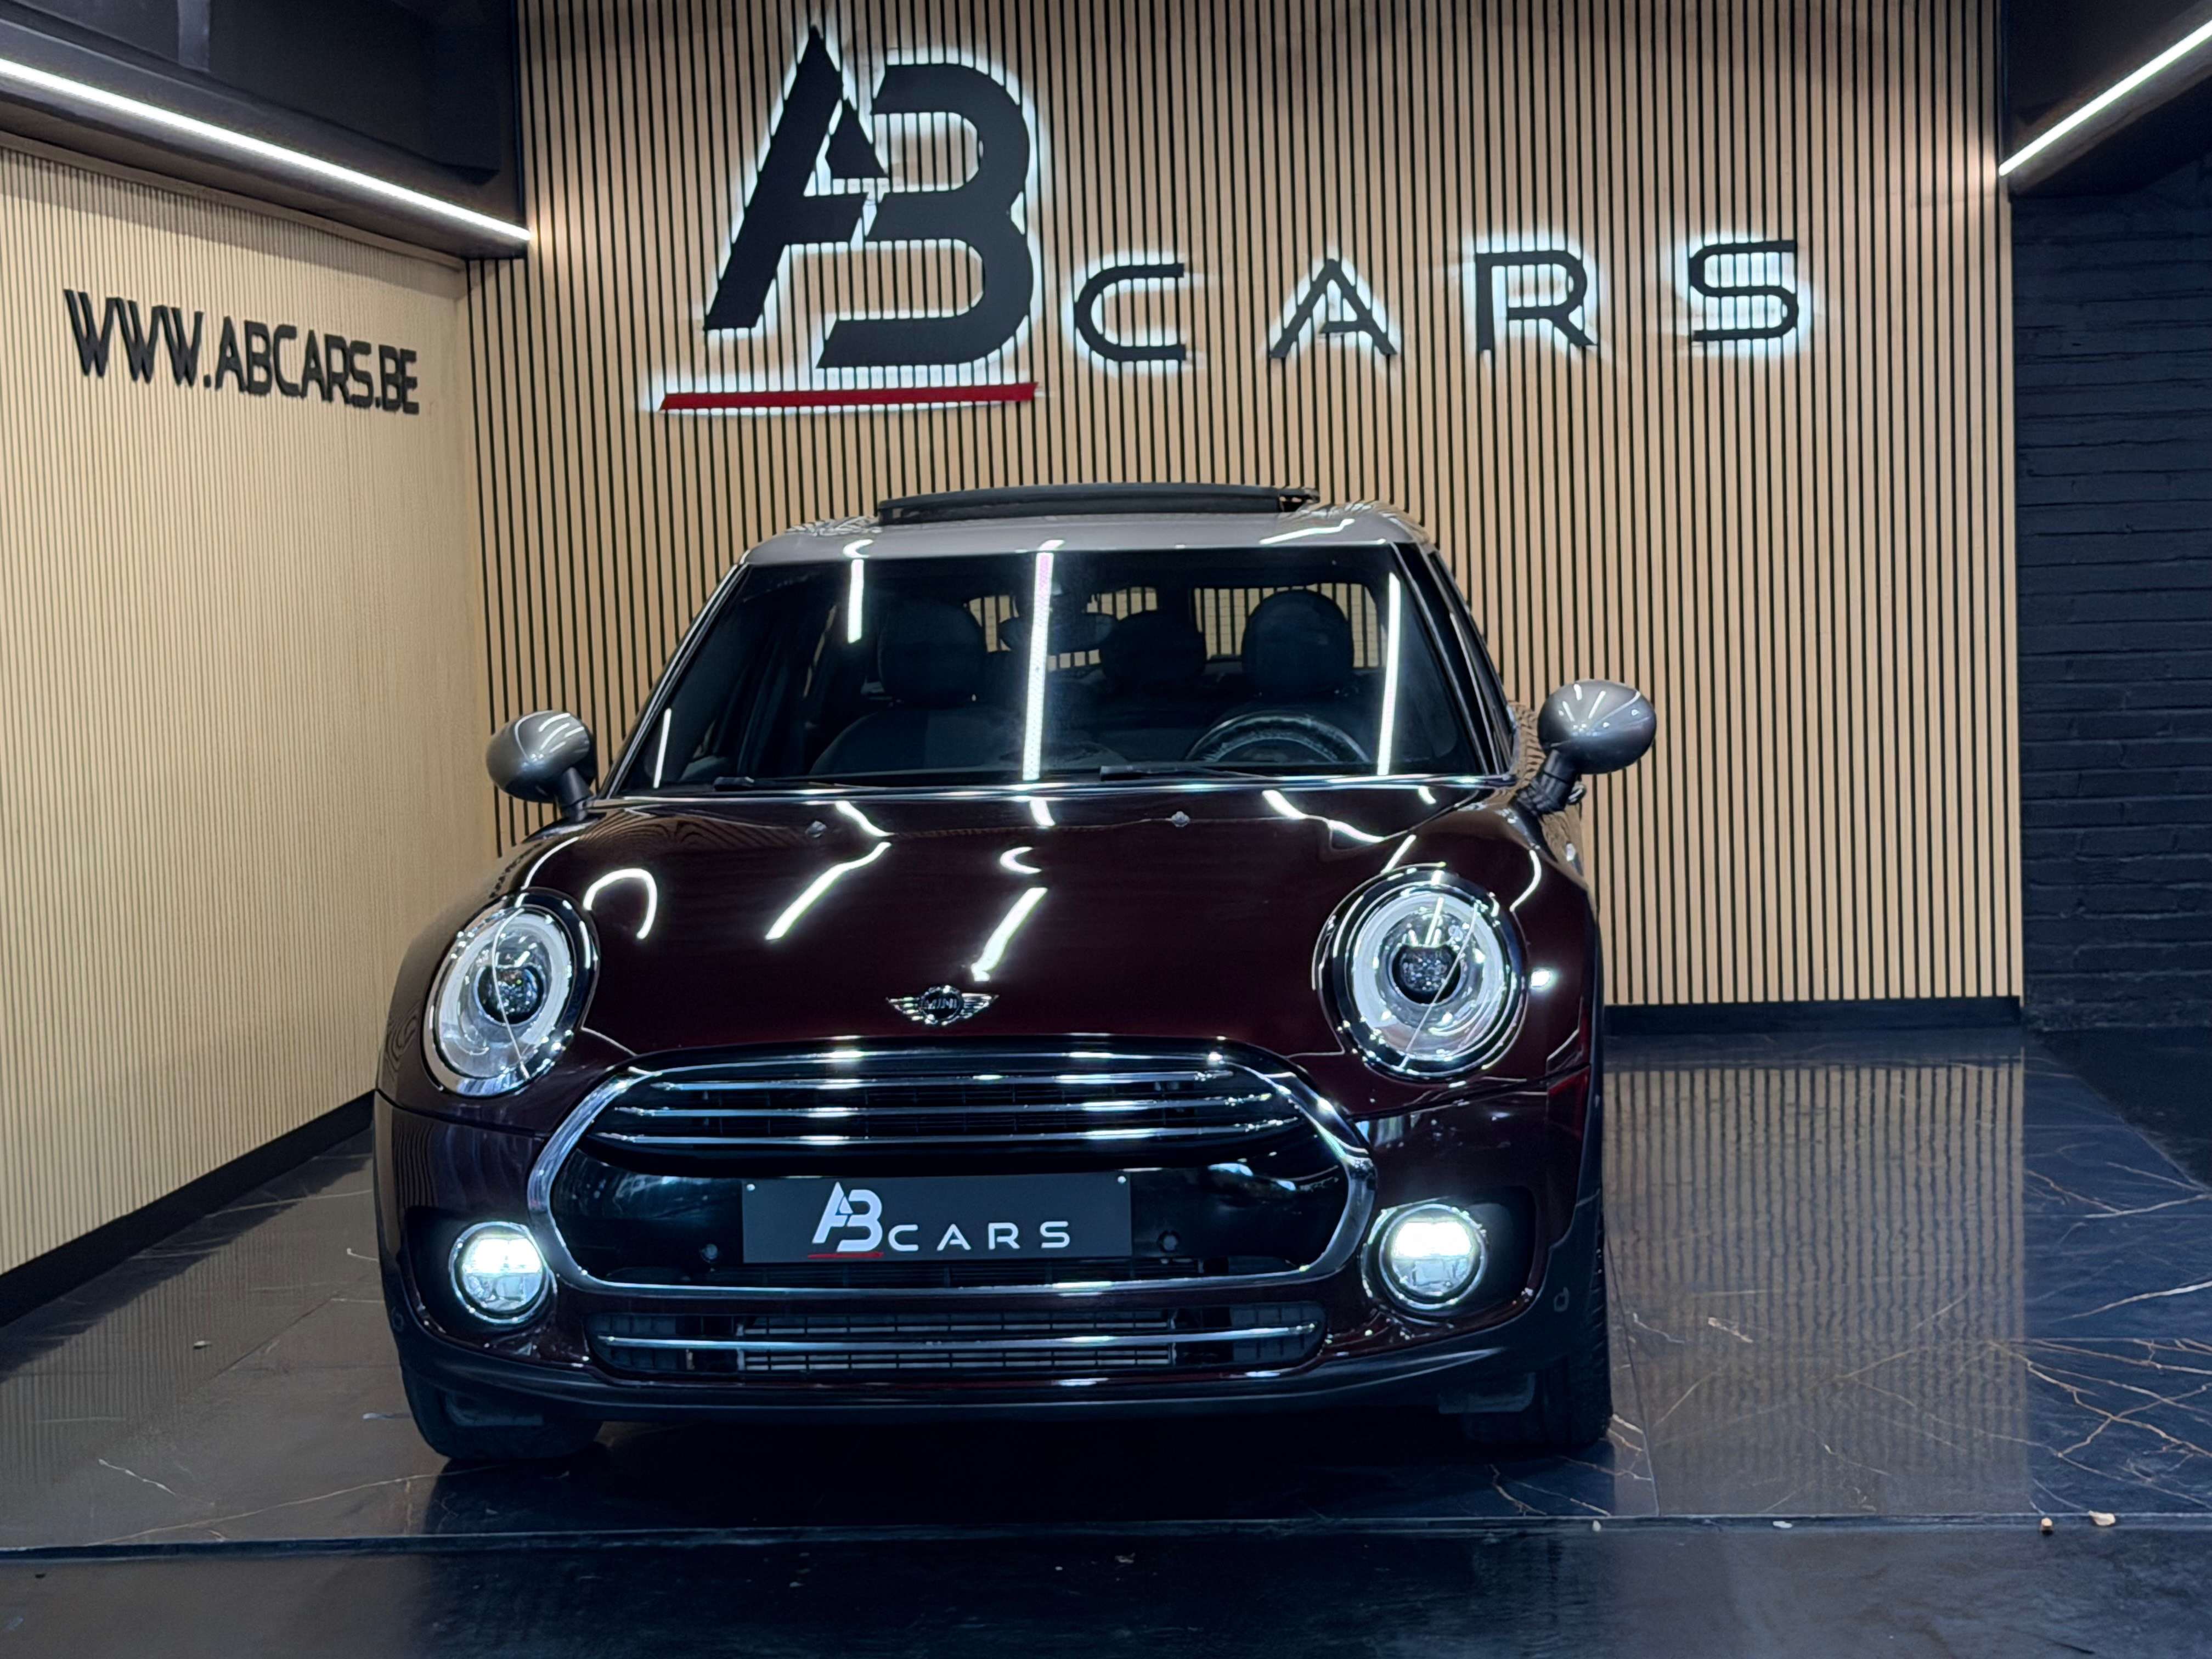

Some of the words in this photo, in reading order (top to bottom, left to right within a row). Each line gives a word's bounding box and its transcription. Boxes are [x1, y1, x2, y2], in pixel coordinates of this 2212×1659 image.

[703, 24, 1034, 369] AB
[1074, 239, 1798, 360] CARS
[63, 288, 419, 415] WWW.ABCARS.BE
[812, 1182, 883, 1252] AB
[888, 1221, 1070, 1251] CARS
